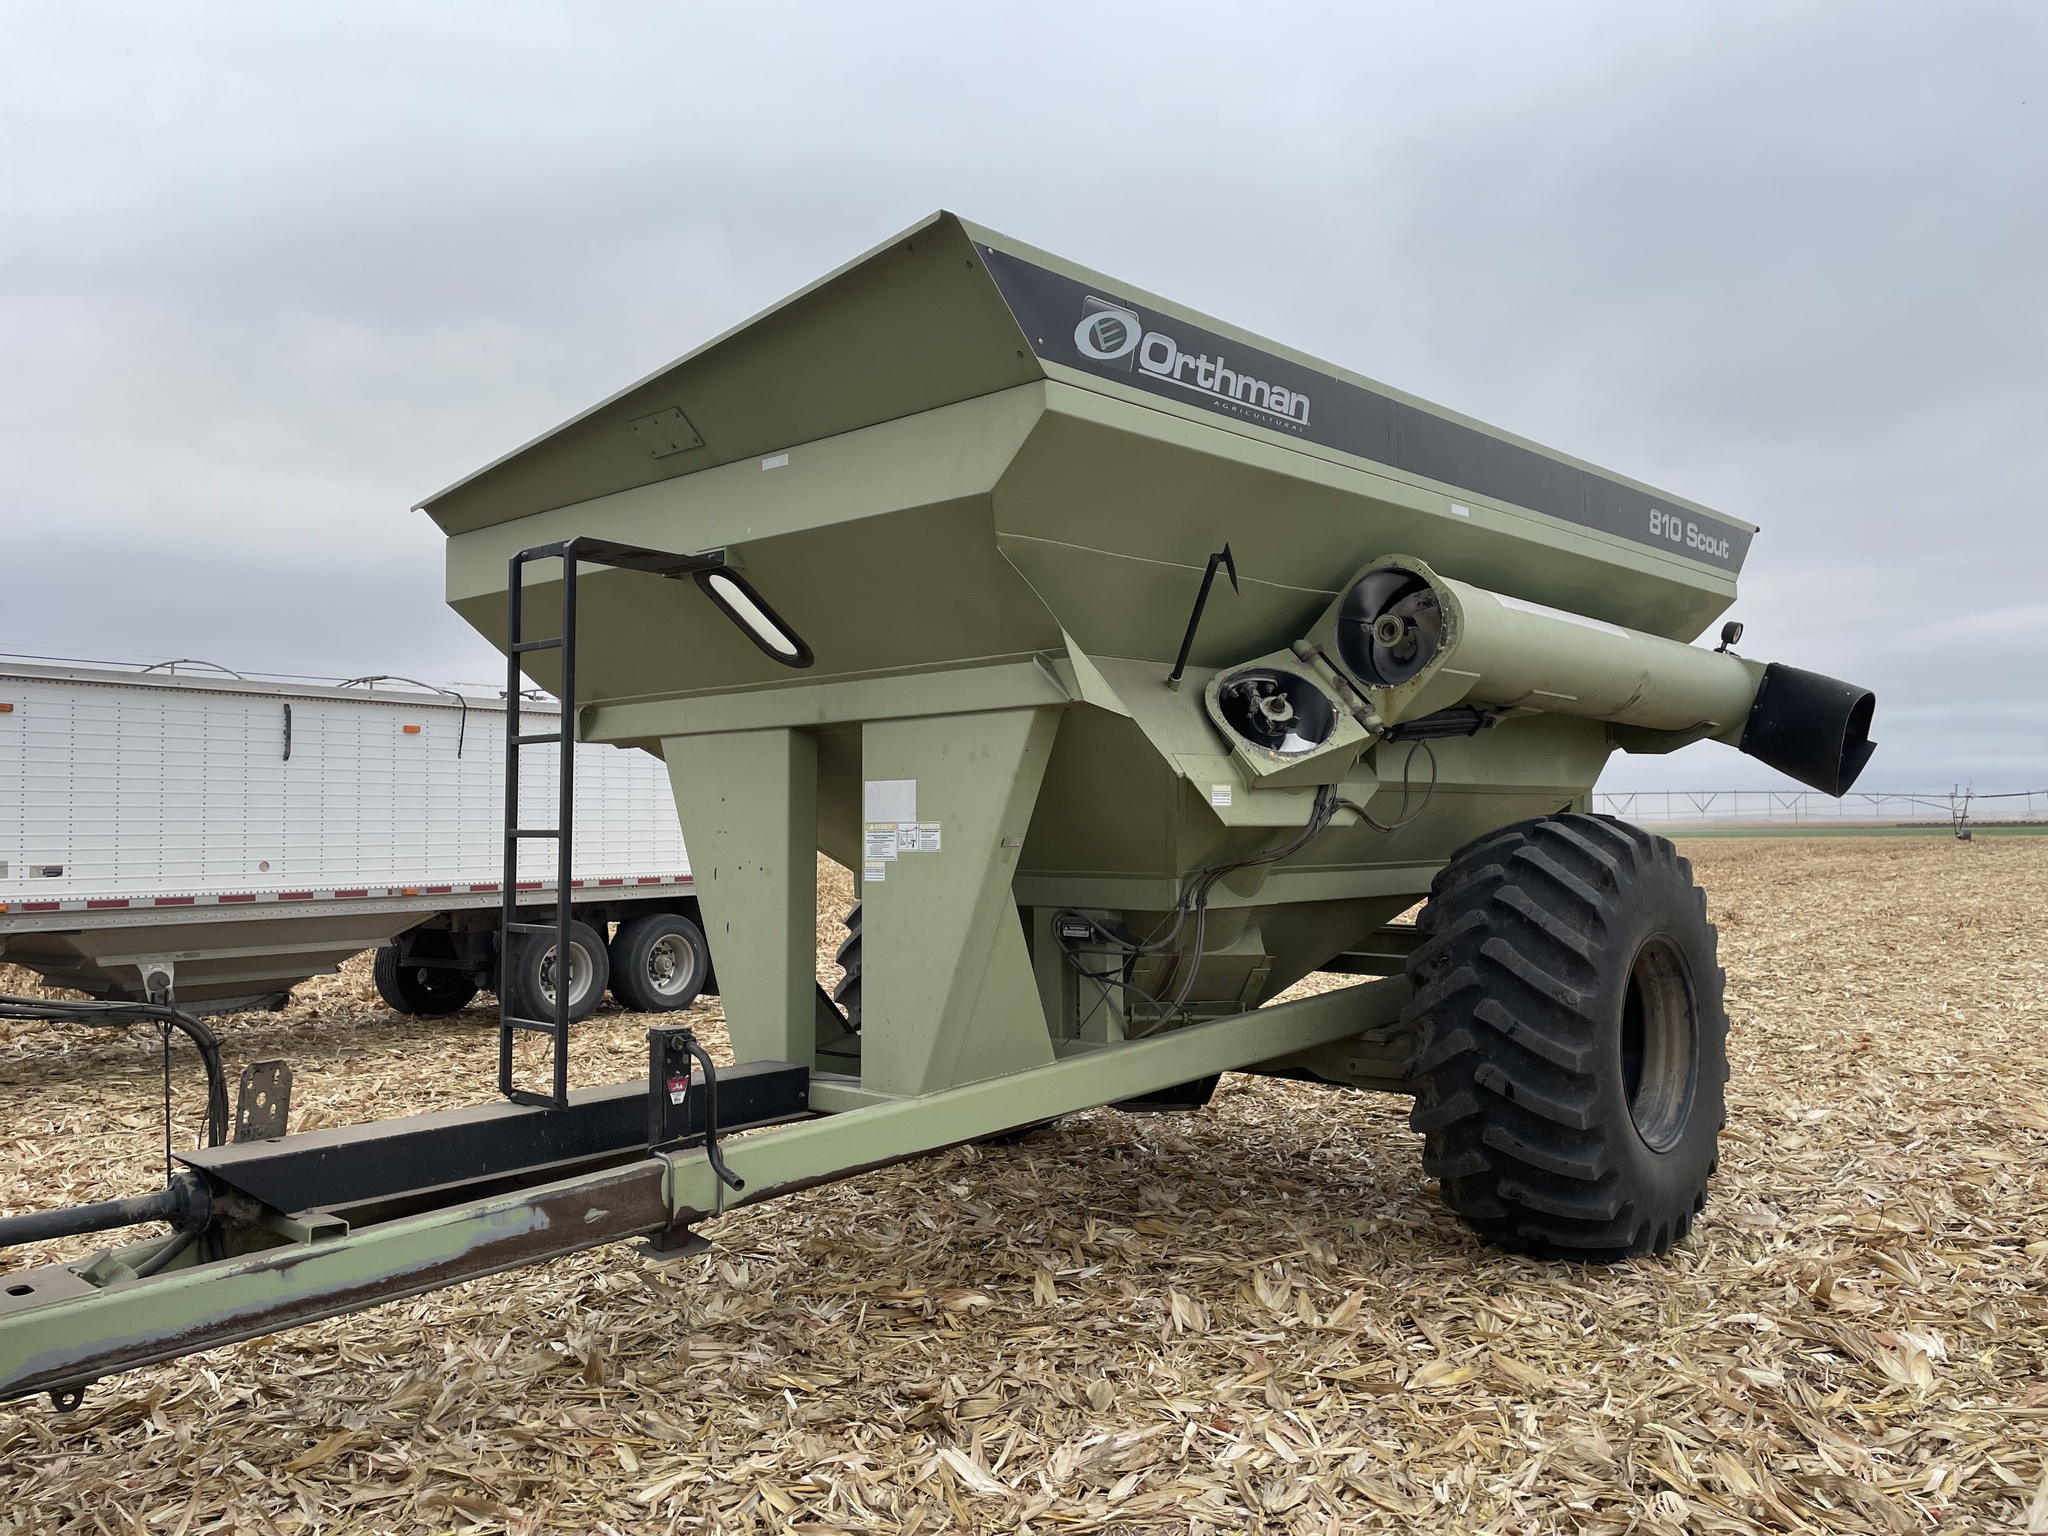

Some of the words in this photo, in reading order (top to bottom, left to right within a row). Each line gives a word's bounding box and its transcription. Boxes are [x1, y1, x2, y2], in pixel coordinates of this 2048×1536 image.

[1139, 332, 1310, 419] Orthman
[1213, 400, 1305, 432] AGRICULTURAL
[1649, 508, 1682, 542] 810
[1686, 521, 1730, 559] Scout
